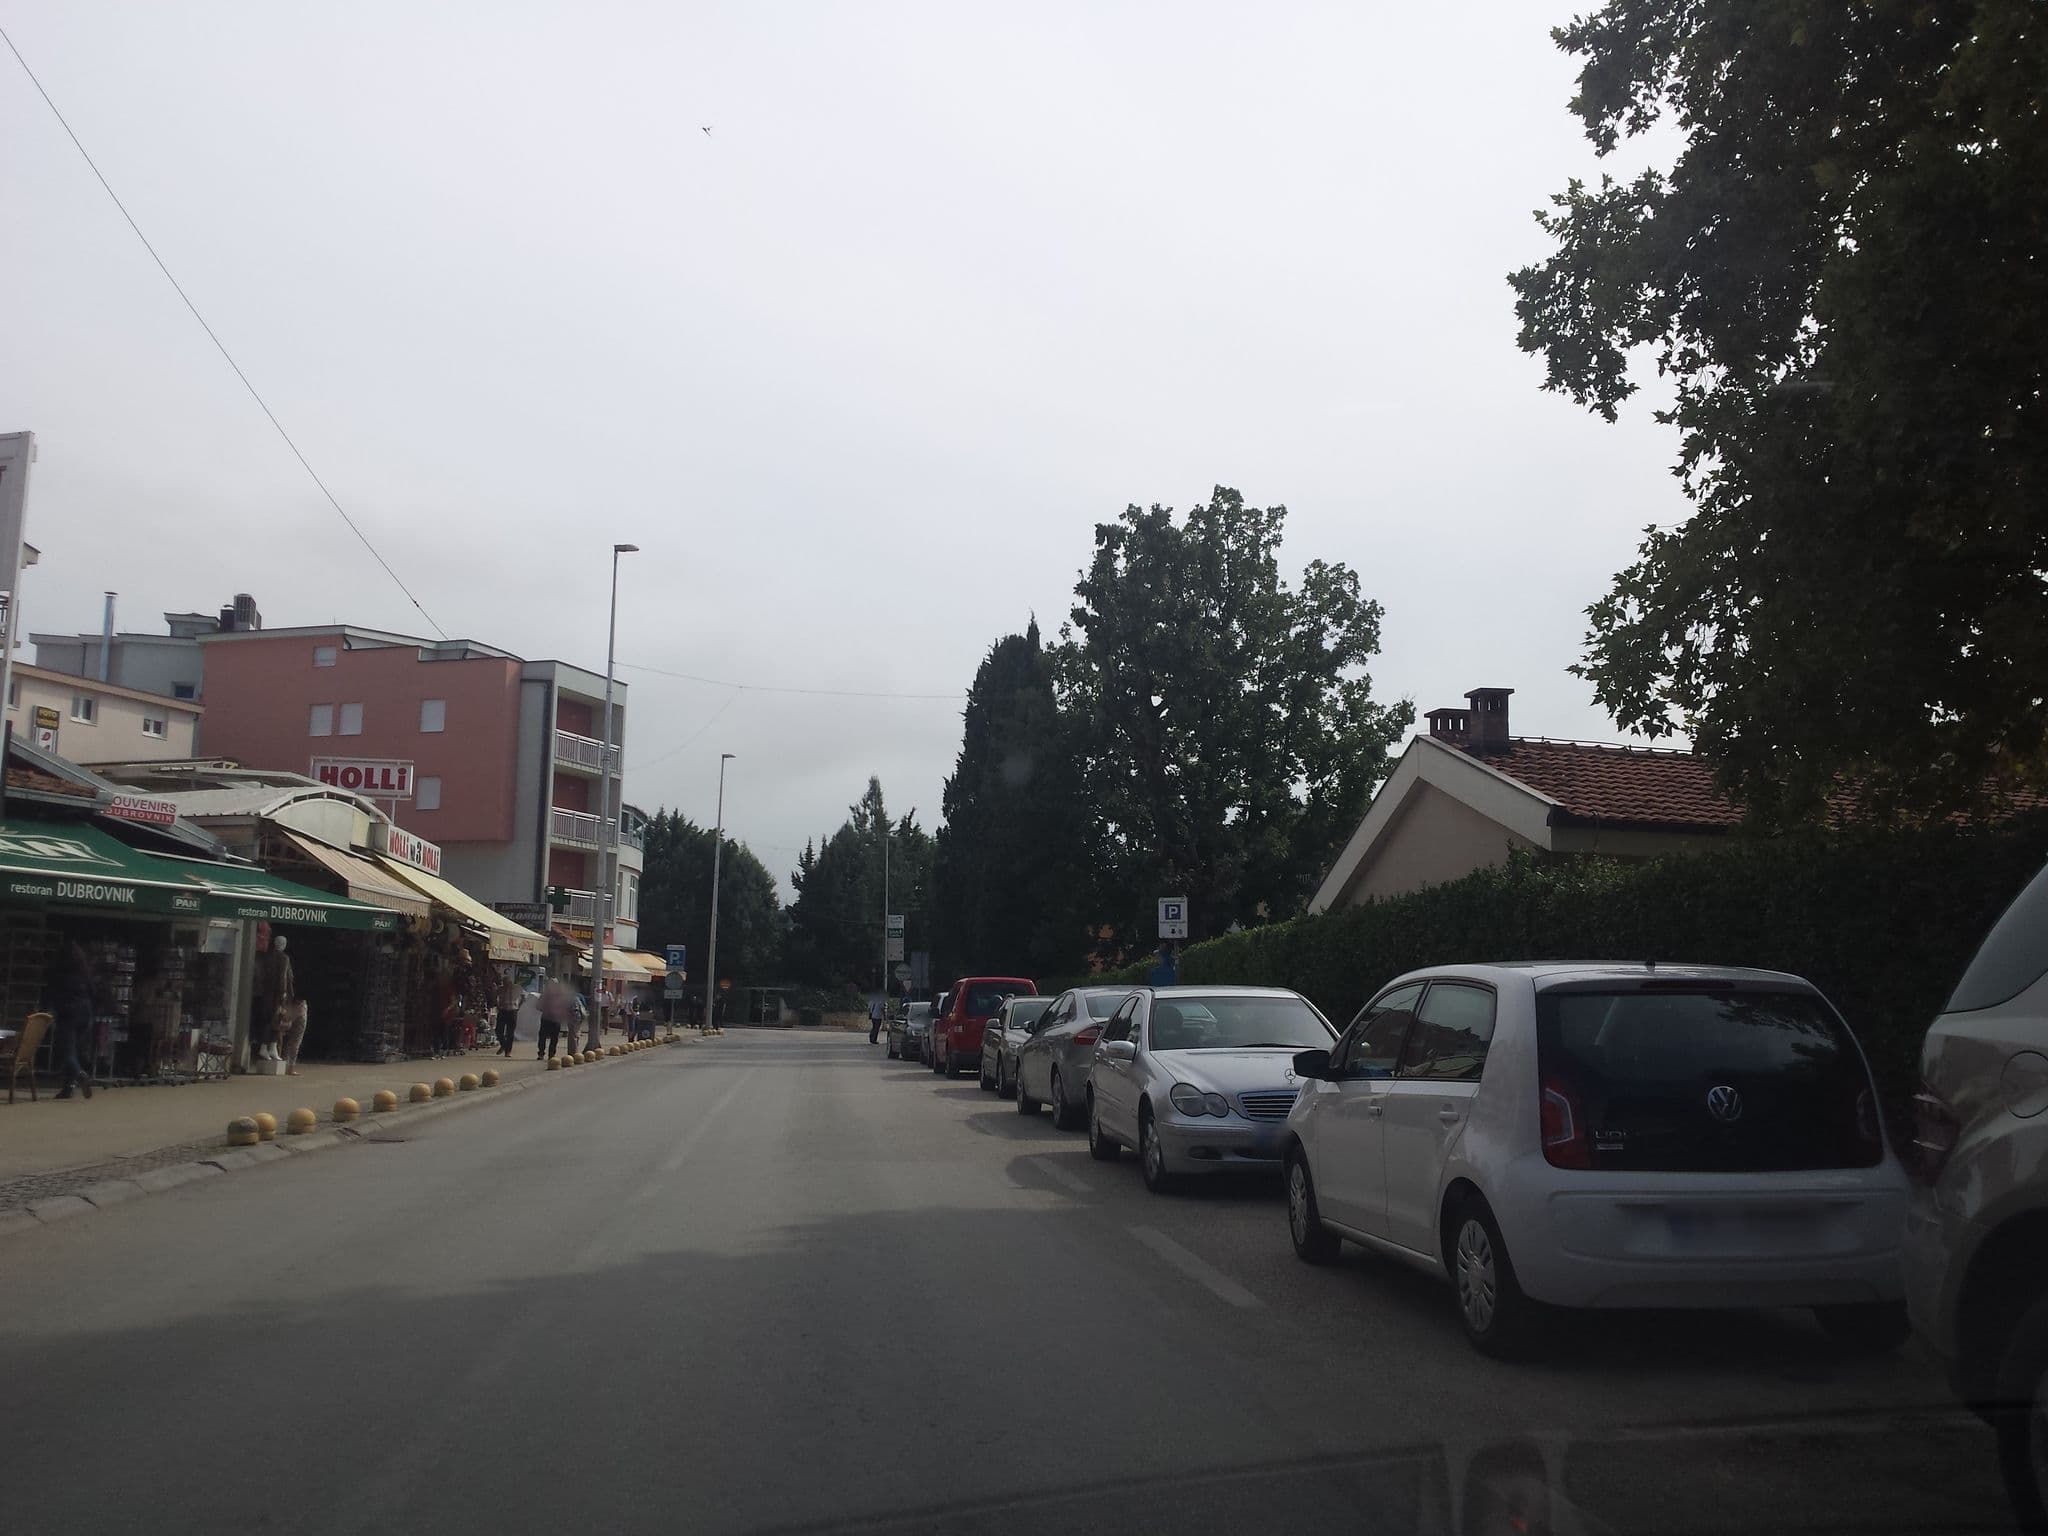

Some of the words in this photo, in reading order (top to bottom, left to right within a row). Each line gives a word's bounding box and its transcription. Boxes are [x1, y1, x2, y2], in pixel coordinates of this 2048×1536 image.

[112, 795, 177, 814] OUVENIRS
[10, 882, 53, 896] restoran
[56, 881, 135, 904] DUBROVNIK
[175, 897, 198, 909] PAN
[238, 906, 268, 918] restoran
[270, 905, 328, 923] DUBROVNIK
[1168, 906, 1179, 919] P
[669, 951, 681, 965] P
